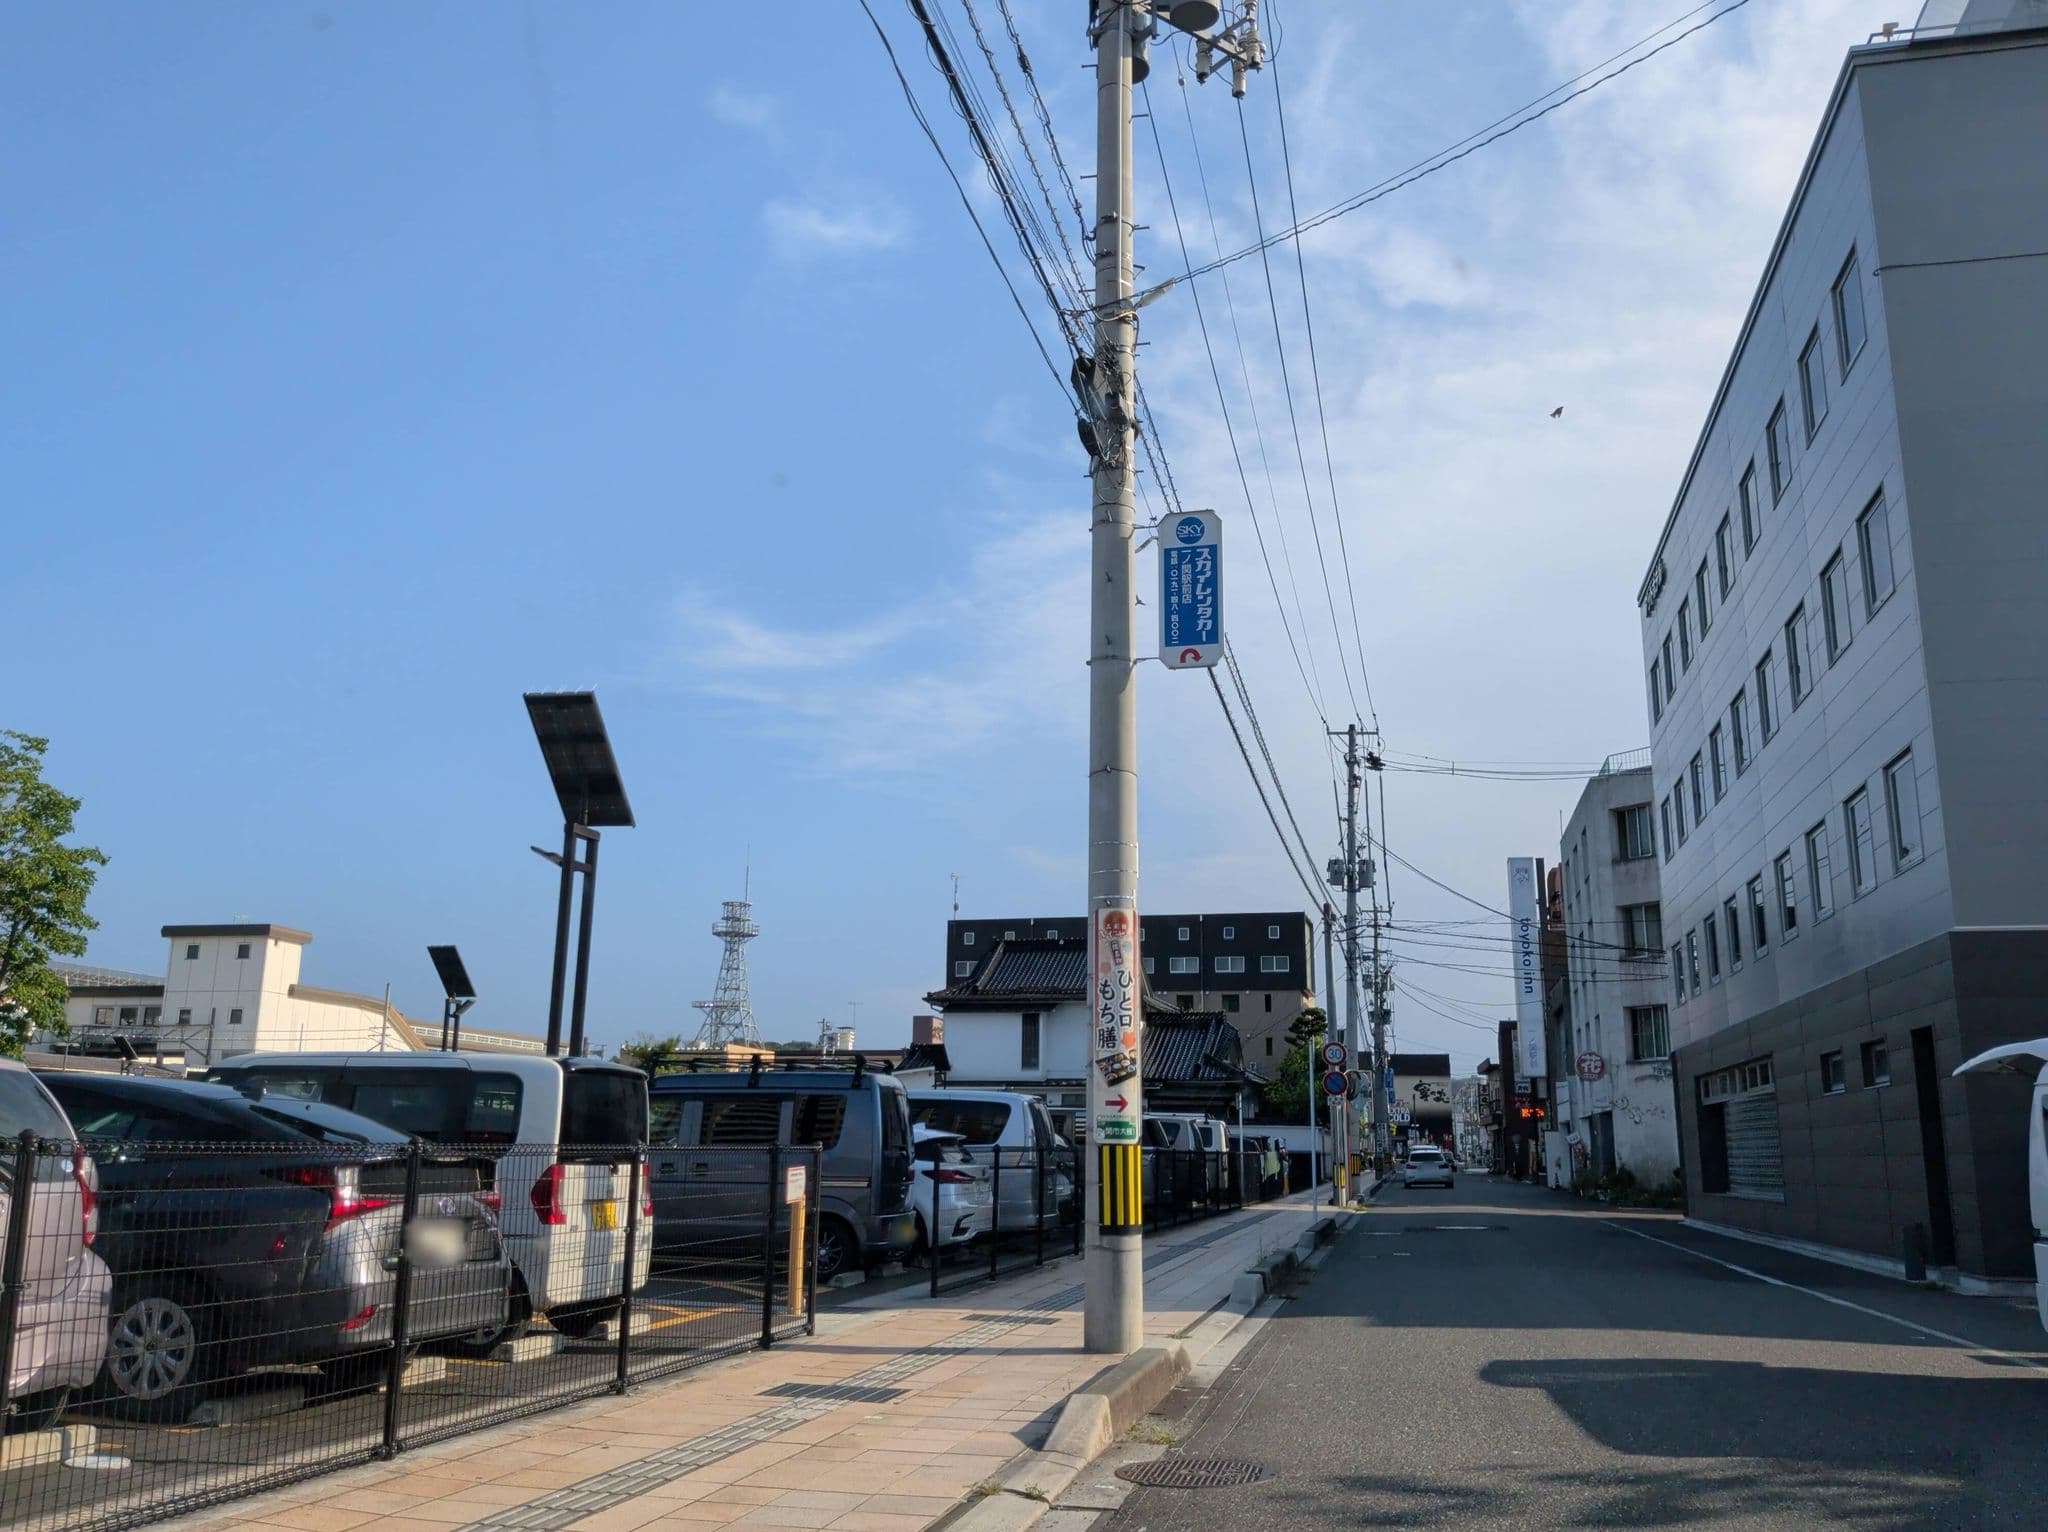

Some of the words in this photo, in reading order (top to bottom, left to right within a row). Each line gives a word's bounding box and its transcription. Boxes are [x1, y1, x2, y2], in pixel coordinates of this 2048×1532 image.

[1177, 524, 1203, 535] SKY
[1181, 549, 1192, 604] 一ノ関駅前店
[1195, 548, 1213, 642] スカイレンタカー
[1520, 917, 1532, 970] toyoko
[1117, 969, 1134, 1027] ひと口
[1523, 971, 1535, 994] inn
[1097, 979, 1118, 1050] もち膳
[1329, 1048, 1341, 1059] 30
